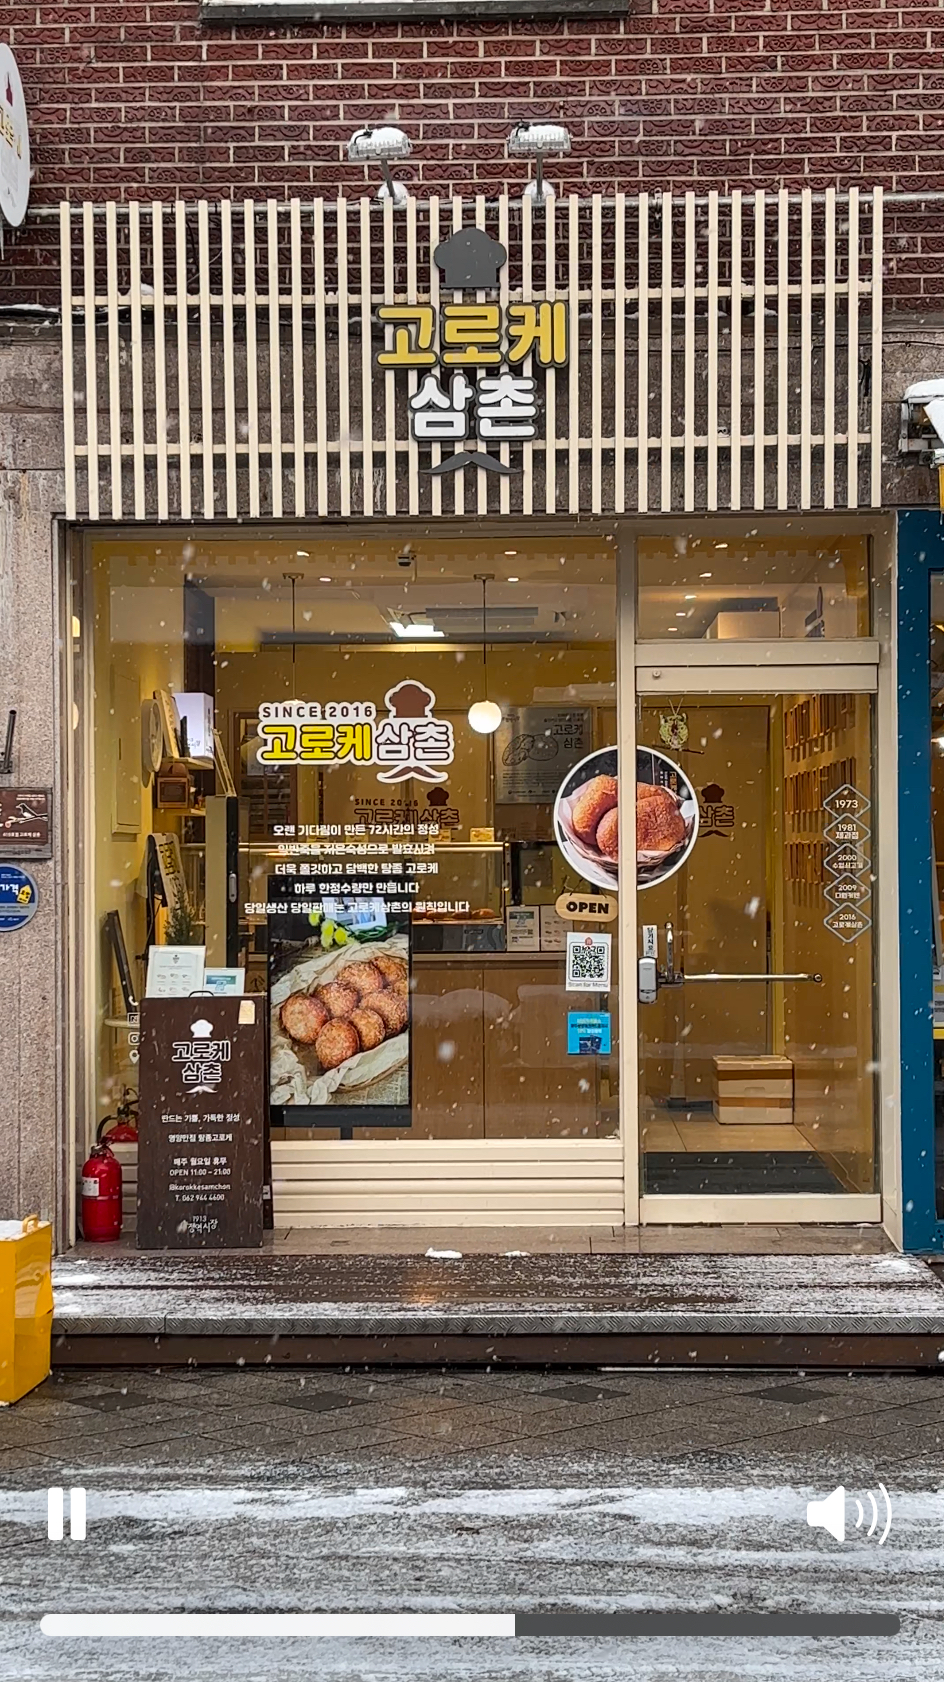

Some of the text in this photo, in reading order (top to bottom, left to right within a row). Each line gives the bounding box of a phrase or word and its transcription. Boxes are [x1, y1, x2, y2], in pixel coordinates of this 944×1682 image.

[376, 300, 569, 368] 고로케
[408, 372, 539, 441] 삼촌
[262, 706, 373, 718] SINCE 2016
[261, 722, 450, 761] 고로케삼촌
[835, 800, 858, 808] 1973
[297, 824, 342, 837] 기다림이
[344, 824, 366, 836] 만든
[368, 823, 415, 835] 72시간의
[417, 823, 439, 835] 정성
[274, 863, 297, 875] 더욱
[345, 863, 379, 875] 담백한
[405, 862, 439, 874] 고로케
[294, 882, 316, 894] 하루
[318, 882, 373, 894] 한정수량만
[244, 901, 471, 914] 당일생산 당일판매는 고로케삼촌의 원칙입니다
[566, 901, 609, 914] OPEN
[171, 1041, 231, 1062] 고로케
[181, 1061, 222, 1083] 삼촌
[173, 1157, 188, 1166] 매주
[190, 1157, 211, 1166] 월요일
